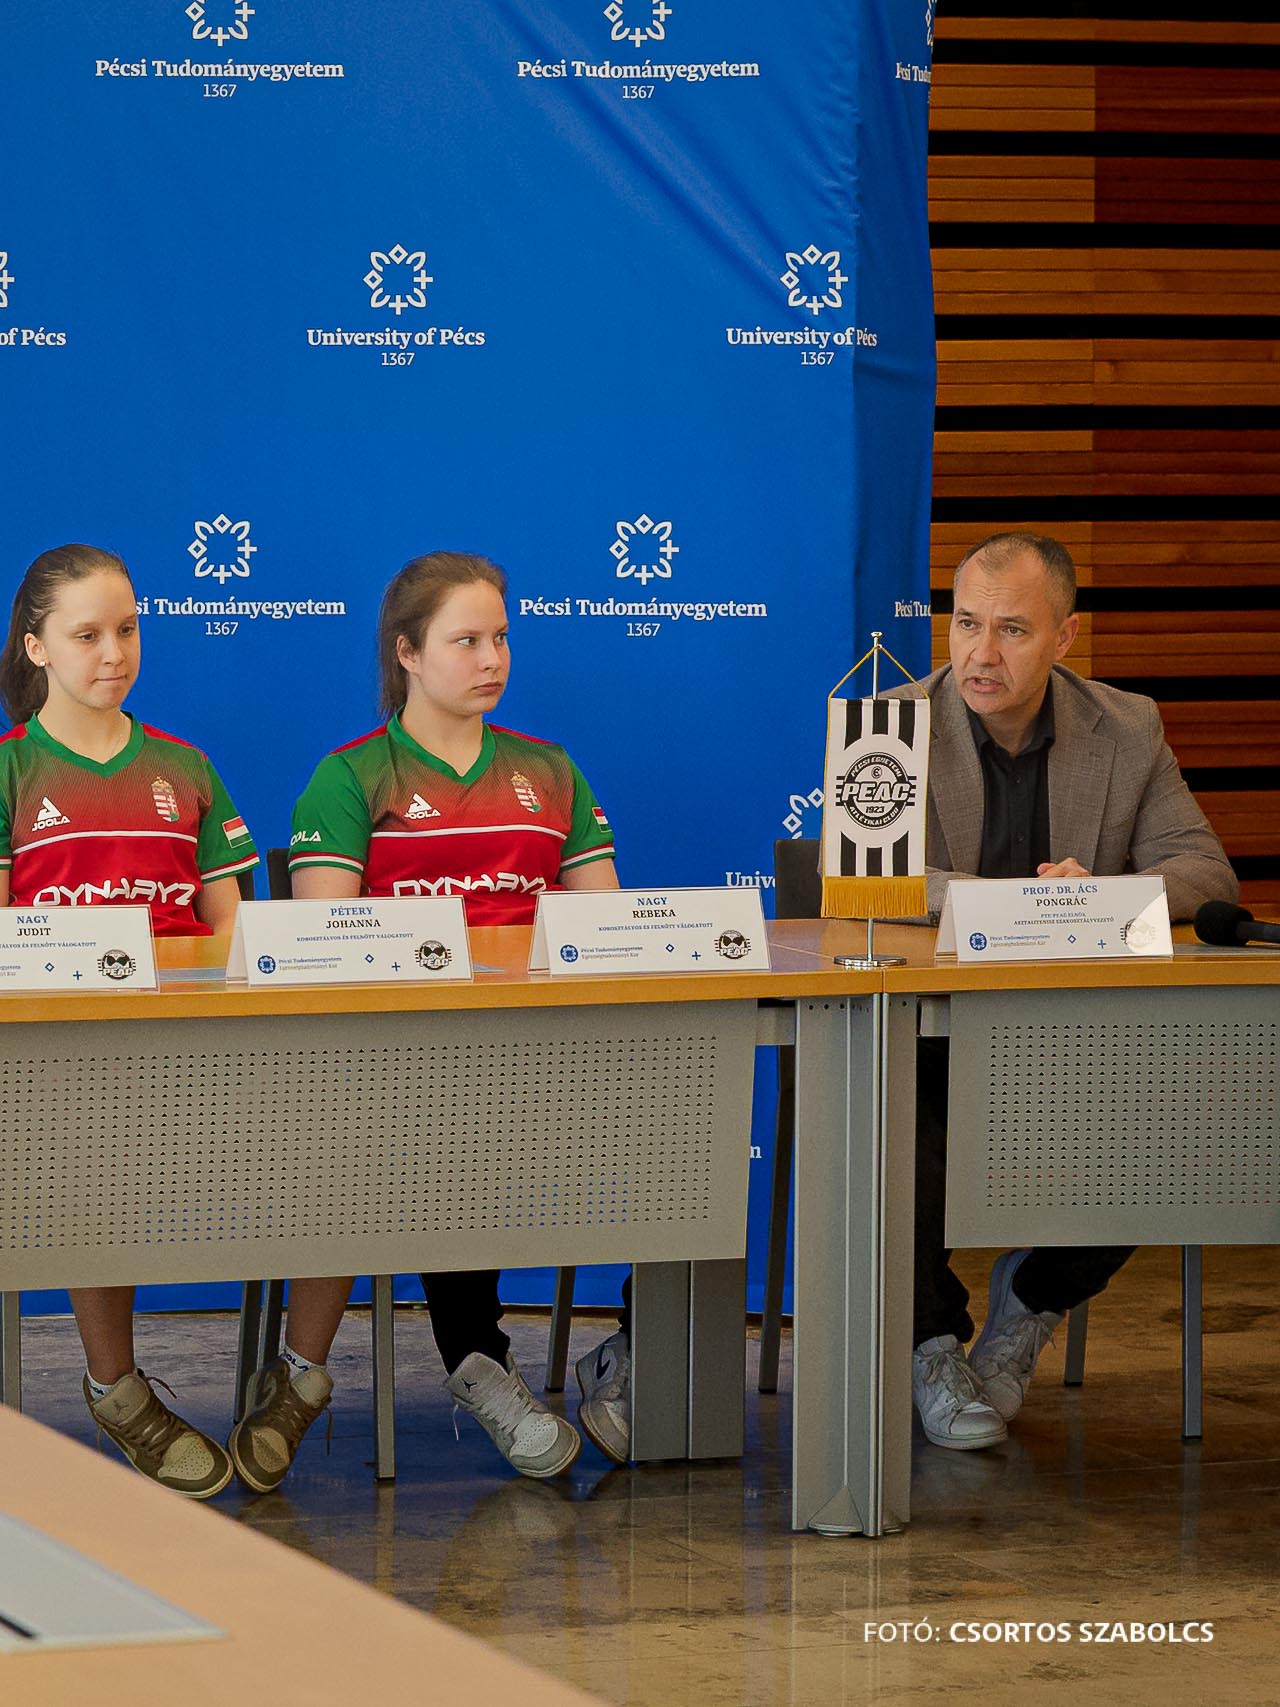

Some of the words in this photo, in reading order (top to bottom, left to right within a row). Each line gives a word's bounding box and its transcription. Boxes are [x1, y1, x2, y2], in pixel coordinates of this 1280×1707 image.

[95, 57, 148, 77] Pécsi
[152, 58, 345, 82] Tudományegyetem
[517, 58, 568, 78] Pécsi
[572, 59, 760, 82] Tudományegyetem
[203, 83, 237, 98] 1367
[622, 85, 655, 99] 1367
[21, 326, 67, 346] Pécs
[306, 327, 413, 350] University
[414, 327, 437, 346] of
[439, 326, 486, 346] Pécs
[726, 326, 831, 349] University
[832, 326, 855, 346] of
[856, 327, 878, 347] Pécs
[381, 352, 415, 366] 1367
[801, 351, 835, 366] 1367
[154, 597, 346, 619] Tudományegyetem
[519, 596, 572, 616] Pécsi
[576, 597, 768, 621] Tudományegyetem
[205, 621, 239, 636] 1367
[626, 622, 661, 637] 1367
[841, 783, 911, 802] PEAC
[866, 806, 885, 814] 1923
[31, 815, 71, 832] JOOLA
[1022, 886, 1054, 895] PROF.
[1057, 885, 1075, 894] DR.
[1077, 884, 1098, 894] ÁCS
[637, 897, 668, 906] NAGY
[1036, 897, 1088, 907] PONGRÁC
[330, 906, 373, 916] PÉTERY
[632, 909, 676, 919] REBEKA
[16, 915, 49, 924] NAGY
[326, 919, 381, 929] JOHANNA
[17, 928, 51, 936] JUDIT
